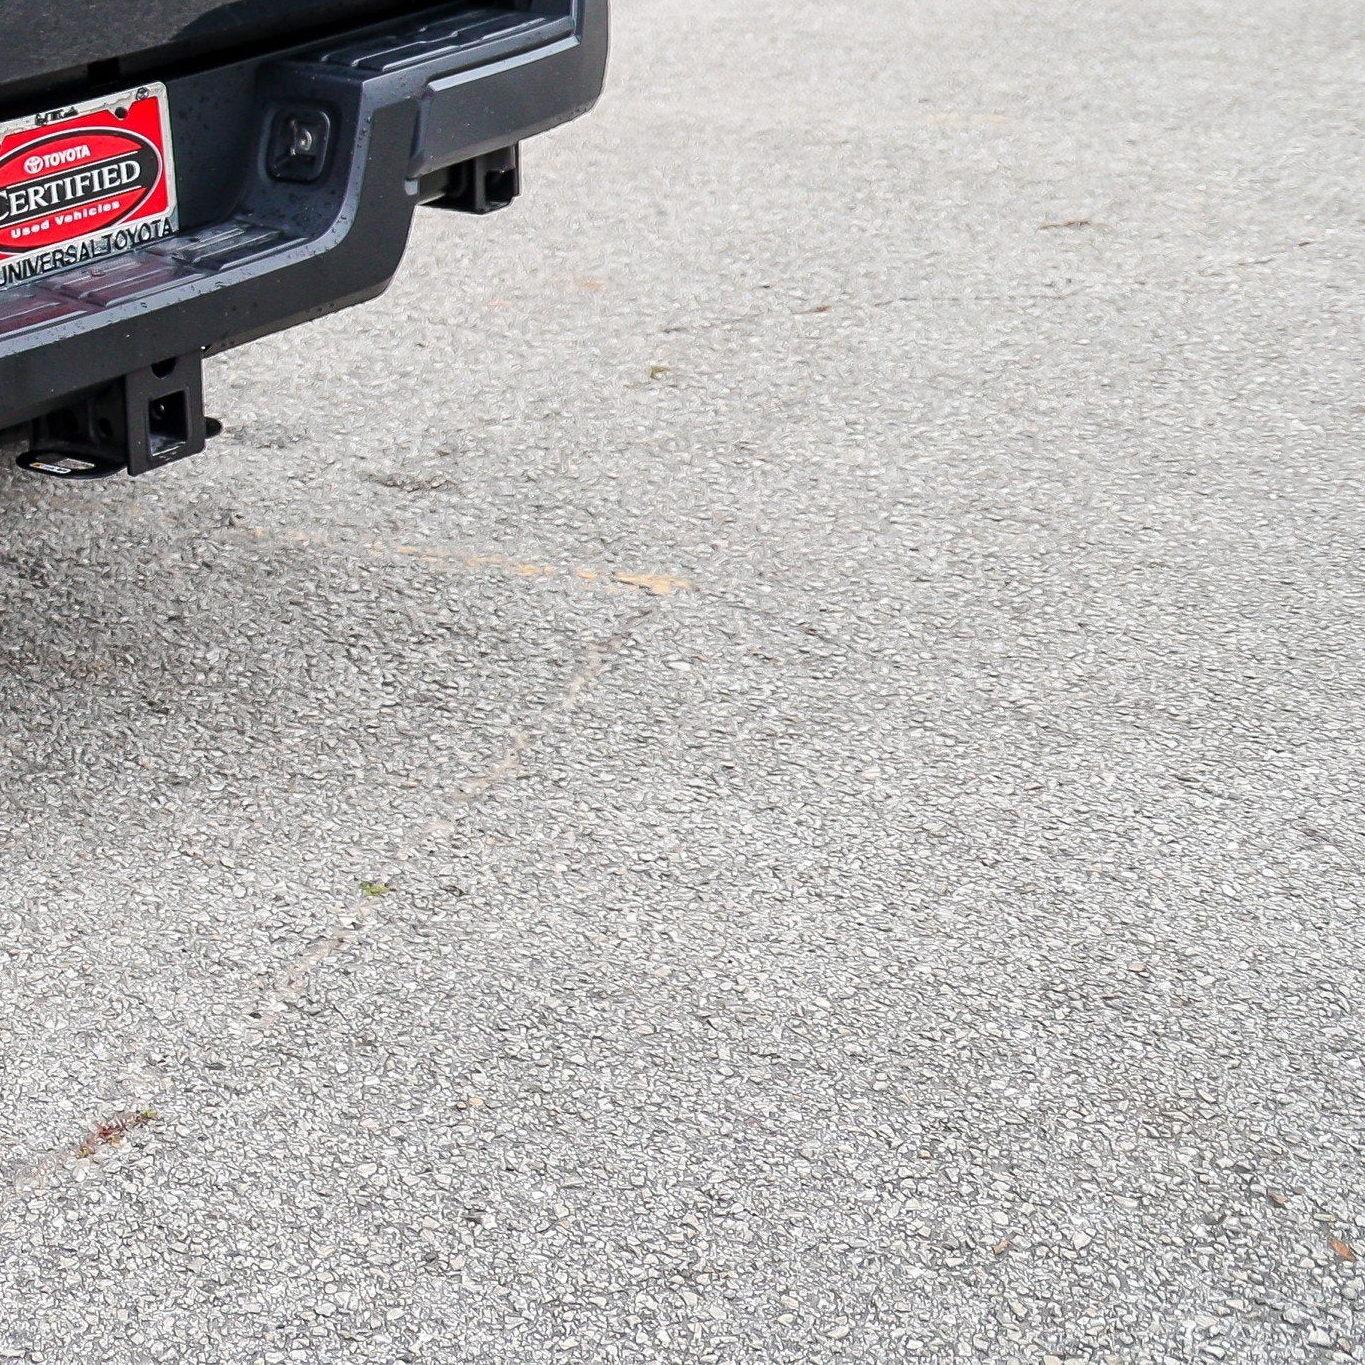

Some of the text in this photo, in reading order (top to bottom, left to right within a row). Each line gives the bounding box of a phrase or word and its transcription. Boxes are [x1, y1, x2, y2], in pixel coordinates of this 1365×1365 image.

[44, 144, 91, 168] TOYOTA
[10, 200, 121, 239] Used Vehicles
[105, 216, 174, 252] TOYOTA
